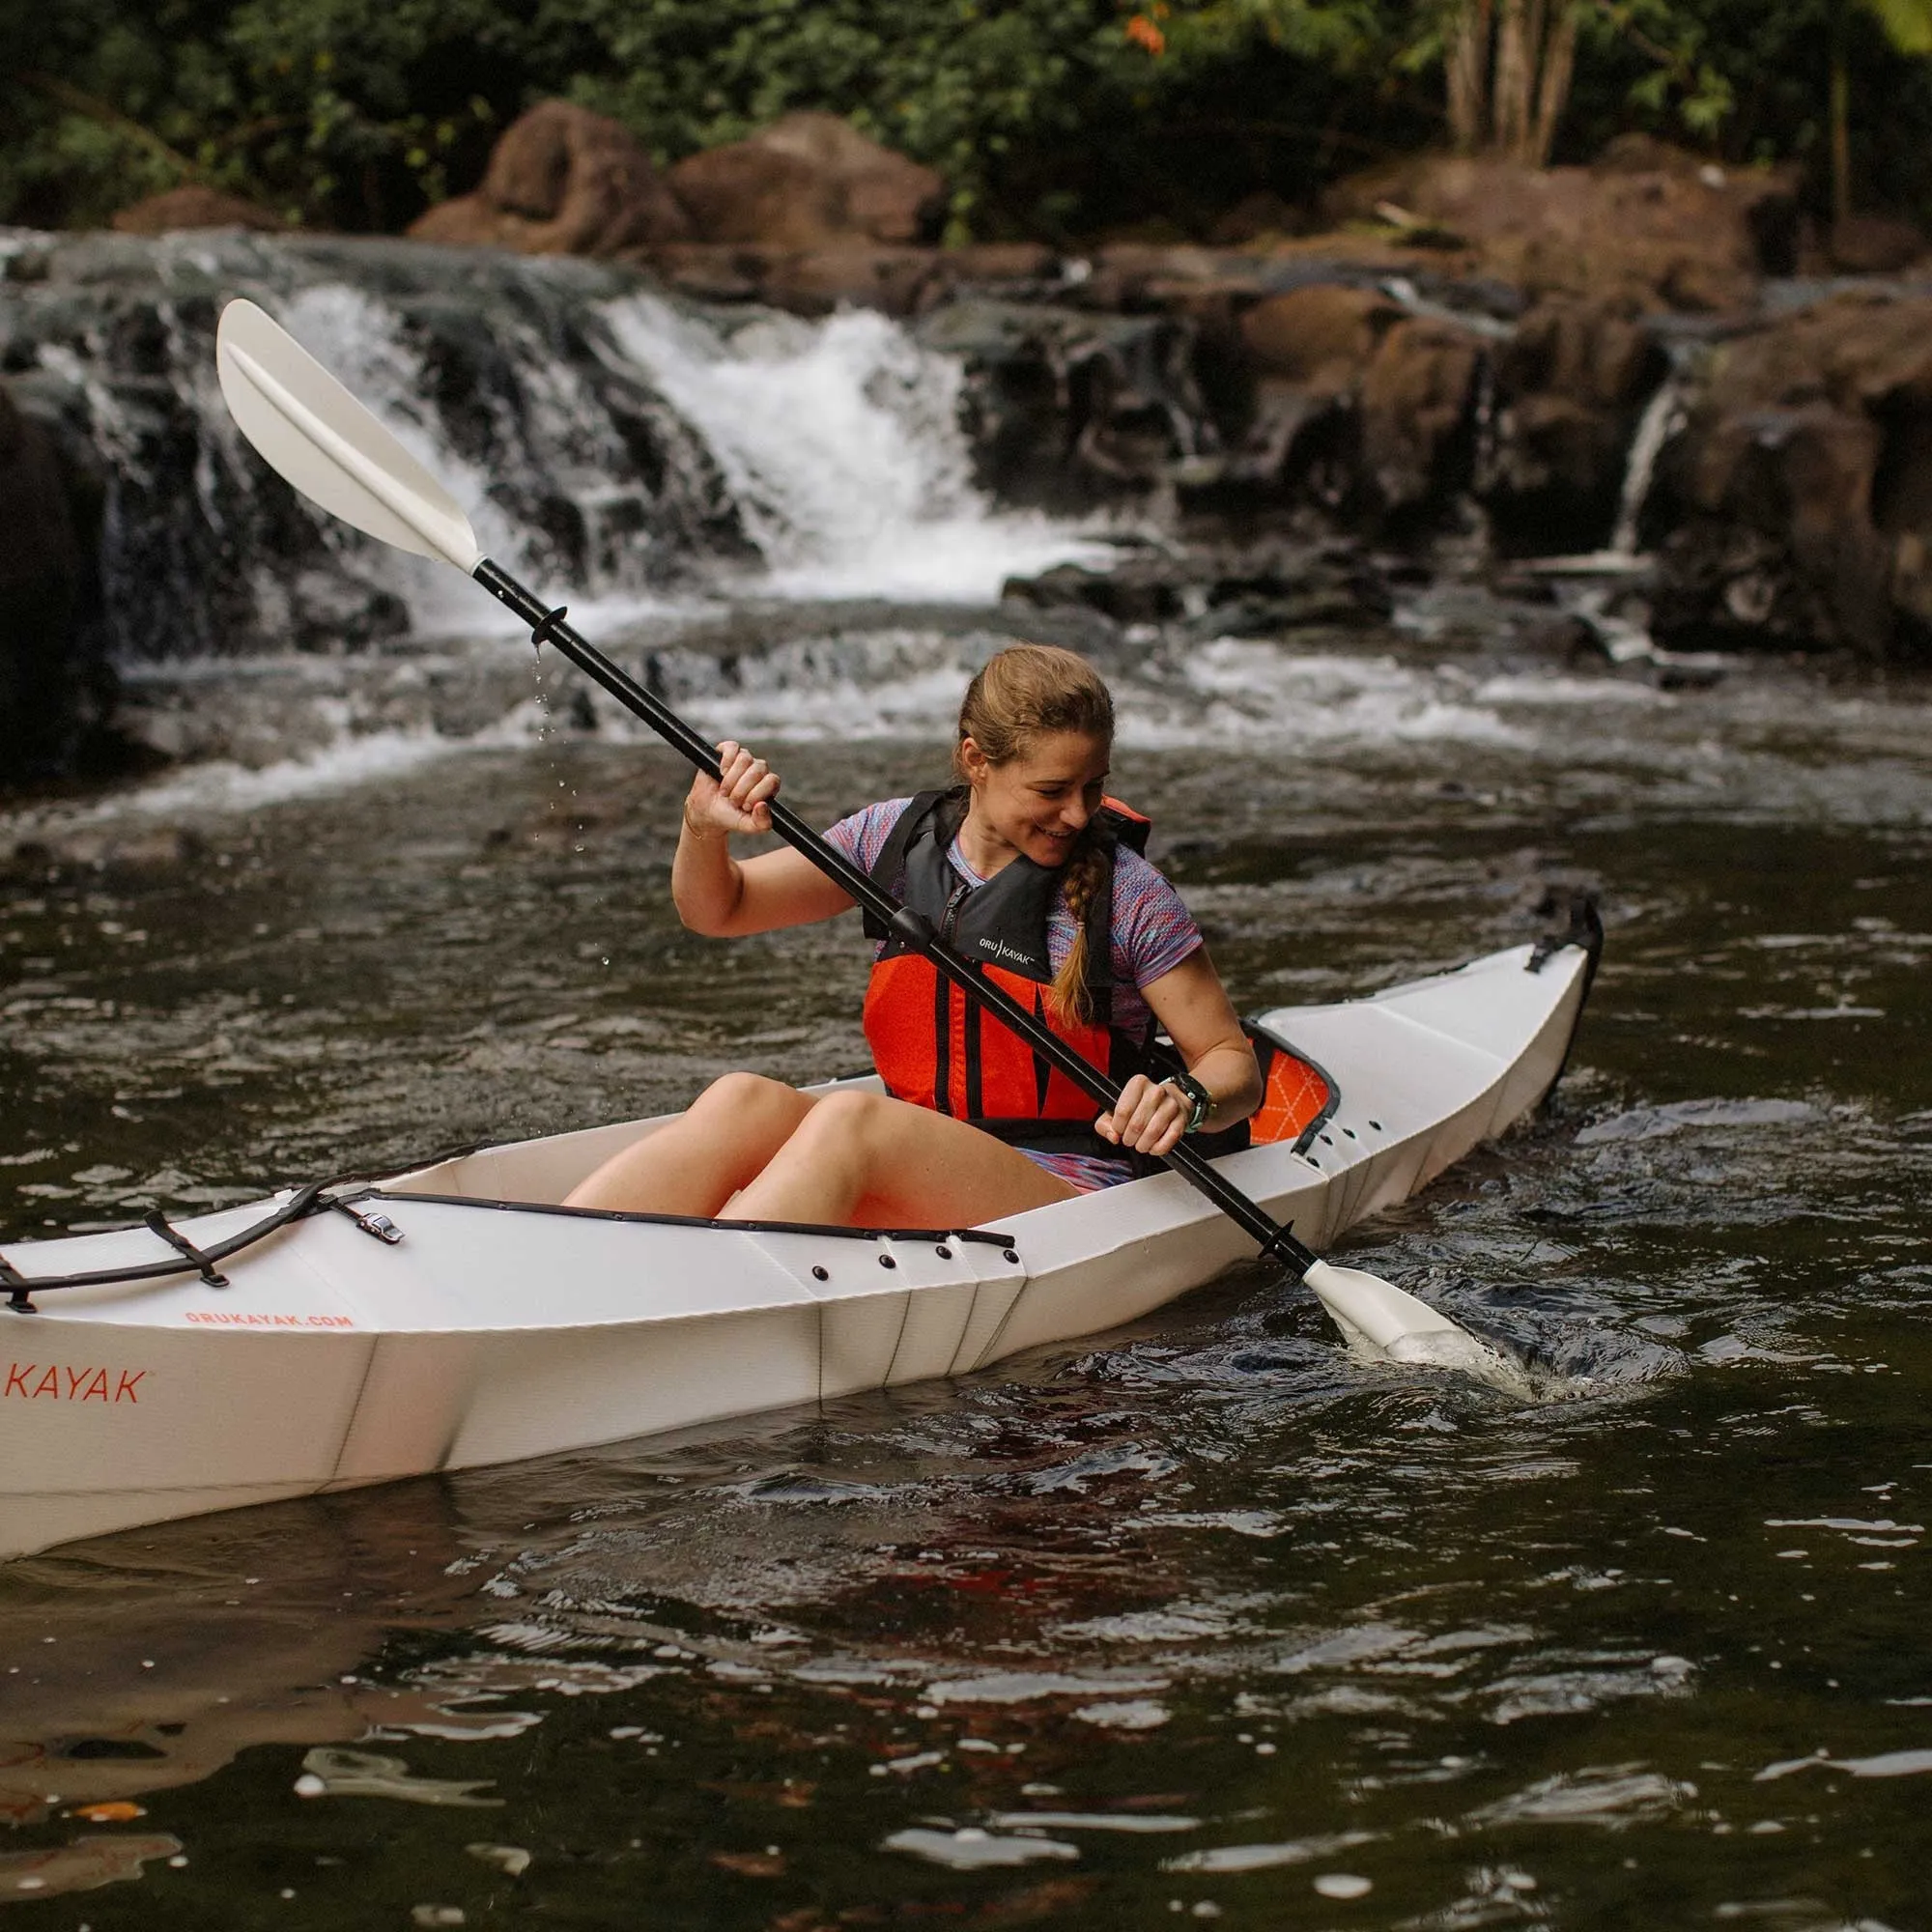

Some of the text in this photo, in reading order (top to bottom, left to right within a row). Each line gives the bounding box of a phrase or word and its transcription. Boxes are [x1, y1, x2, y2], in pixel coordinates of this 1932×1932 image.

[980, 938, 1031, 965] ORU KAYAK
[185, 1312, 354, 1327] ORUKAYAK.COM
[5, 1363, 146, 1403] KAYAK
